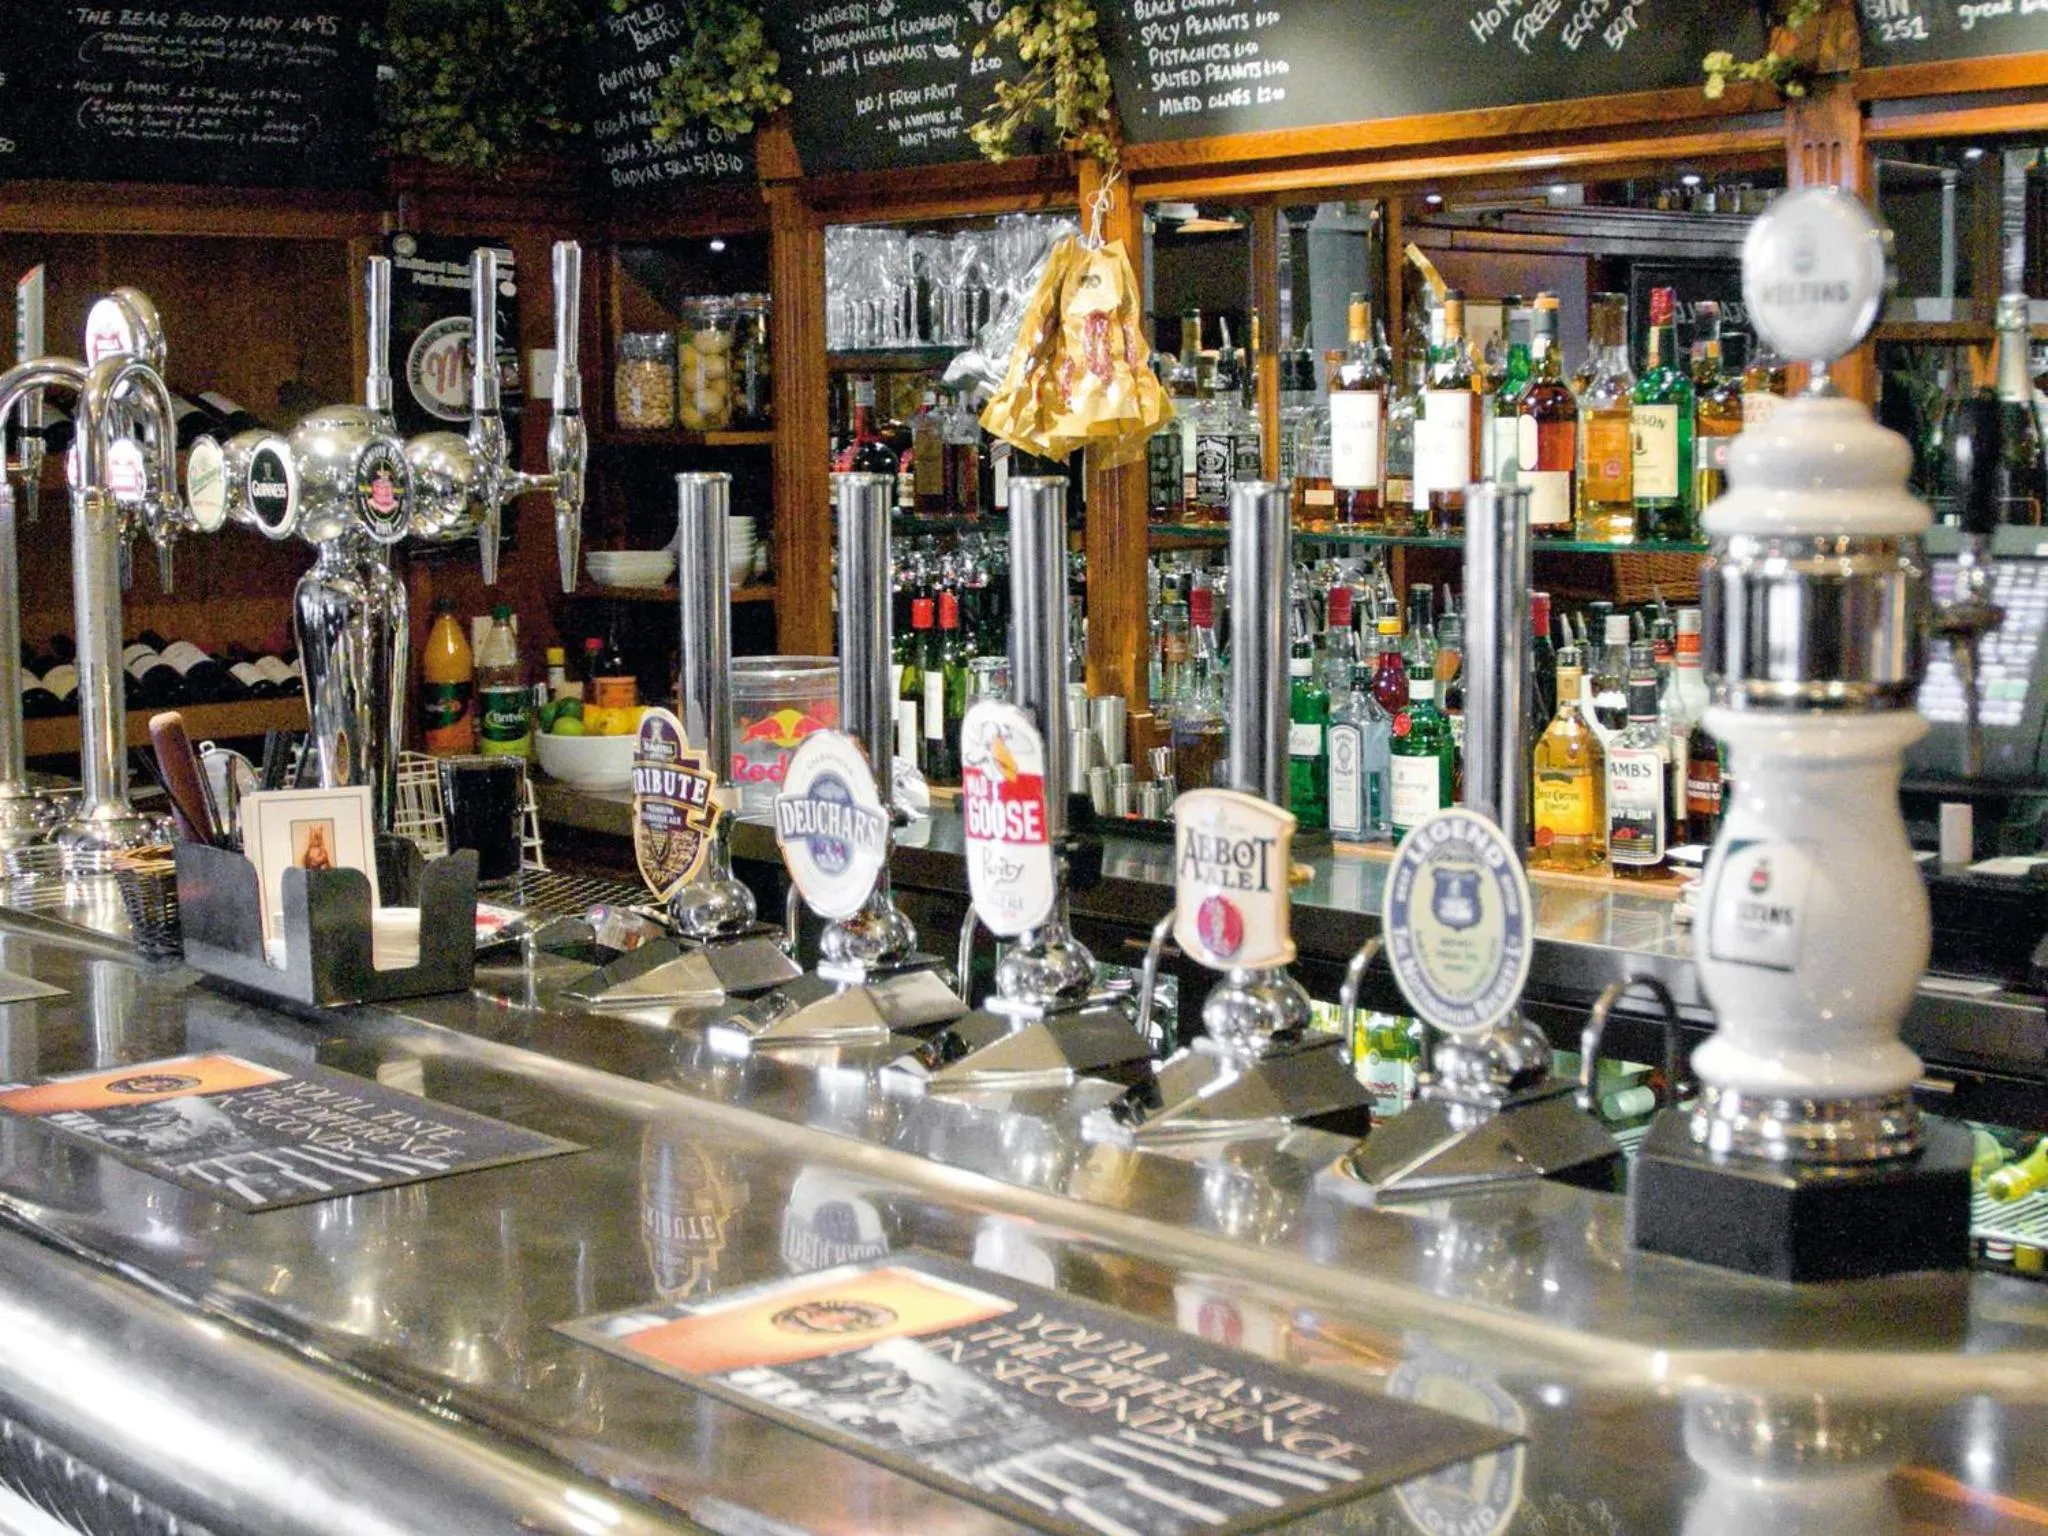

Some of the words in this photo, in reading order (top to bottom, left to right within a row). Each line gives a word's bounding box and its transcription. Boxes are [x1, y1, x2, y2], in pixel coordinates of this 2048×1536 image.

[120, 9, 170, 27] BEAR
[802, 3, 870, 33] CRANBERRY
[1140, 20, 1181, 47] SPICY
[1185, 12, 1250, 38] PEANUTS
[1879, 15, 1930, 42] 251
[820, 55, 848, 78] LIME
[1148, 42, 1231, 68] PISTACHIOS
[1151, 68, 1202, 93] SALTED
[1205, 61, 1262, 85] PEANUTS
[251, 480, 288, 499] GUINNESS
[732, 751, 789, 783] Red
[632, 767, 708, 805] TRIBUTE
[780, 799, 879, 848] DEUCHARS
[967, 800, 1042, 841] GOOSE
[1406, 818, 1506, 869] LEGEND
[371, 1109, 467, 1141] TASTE
[1178, 1365, 1341, 1424] TASTE
